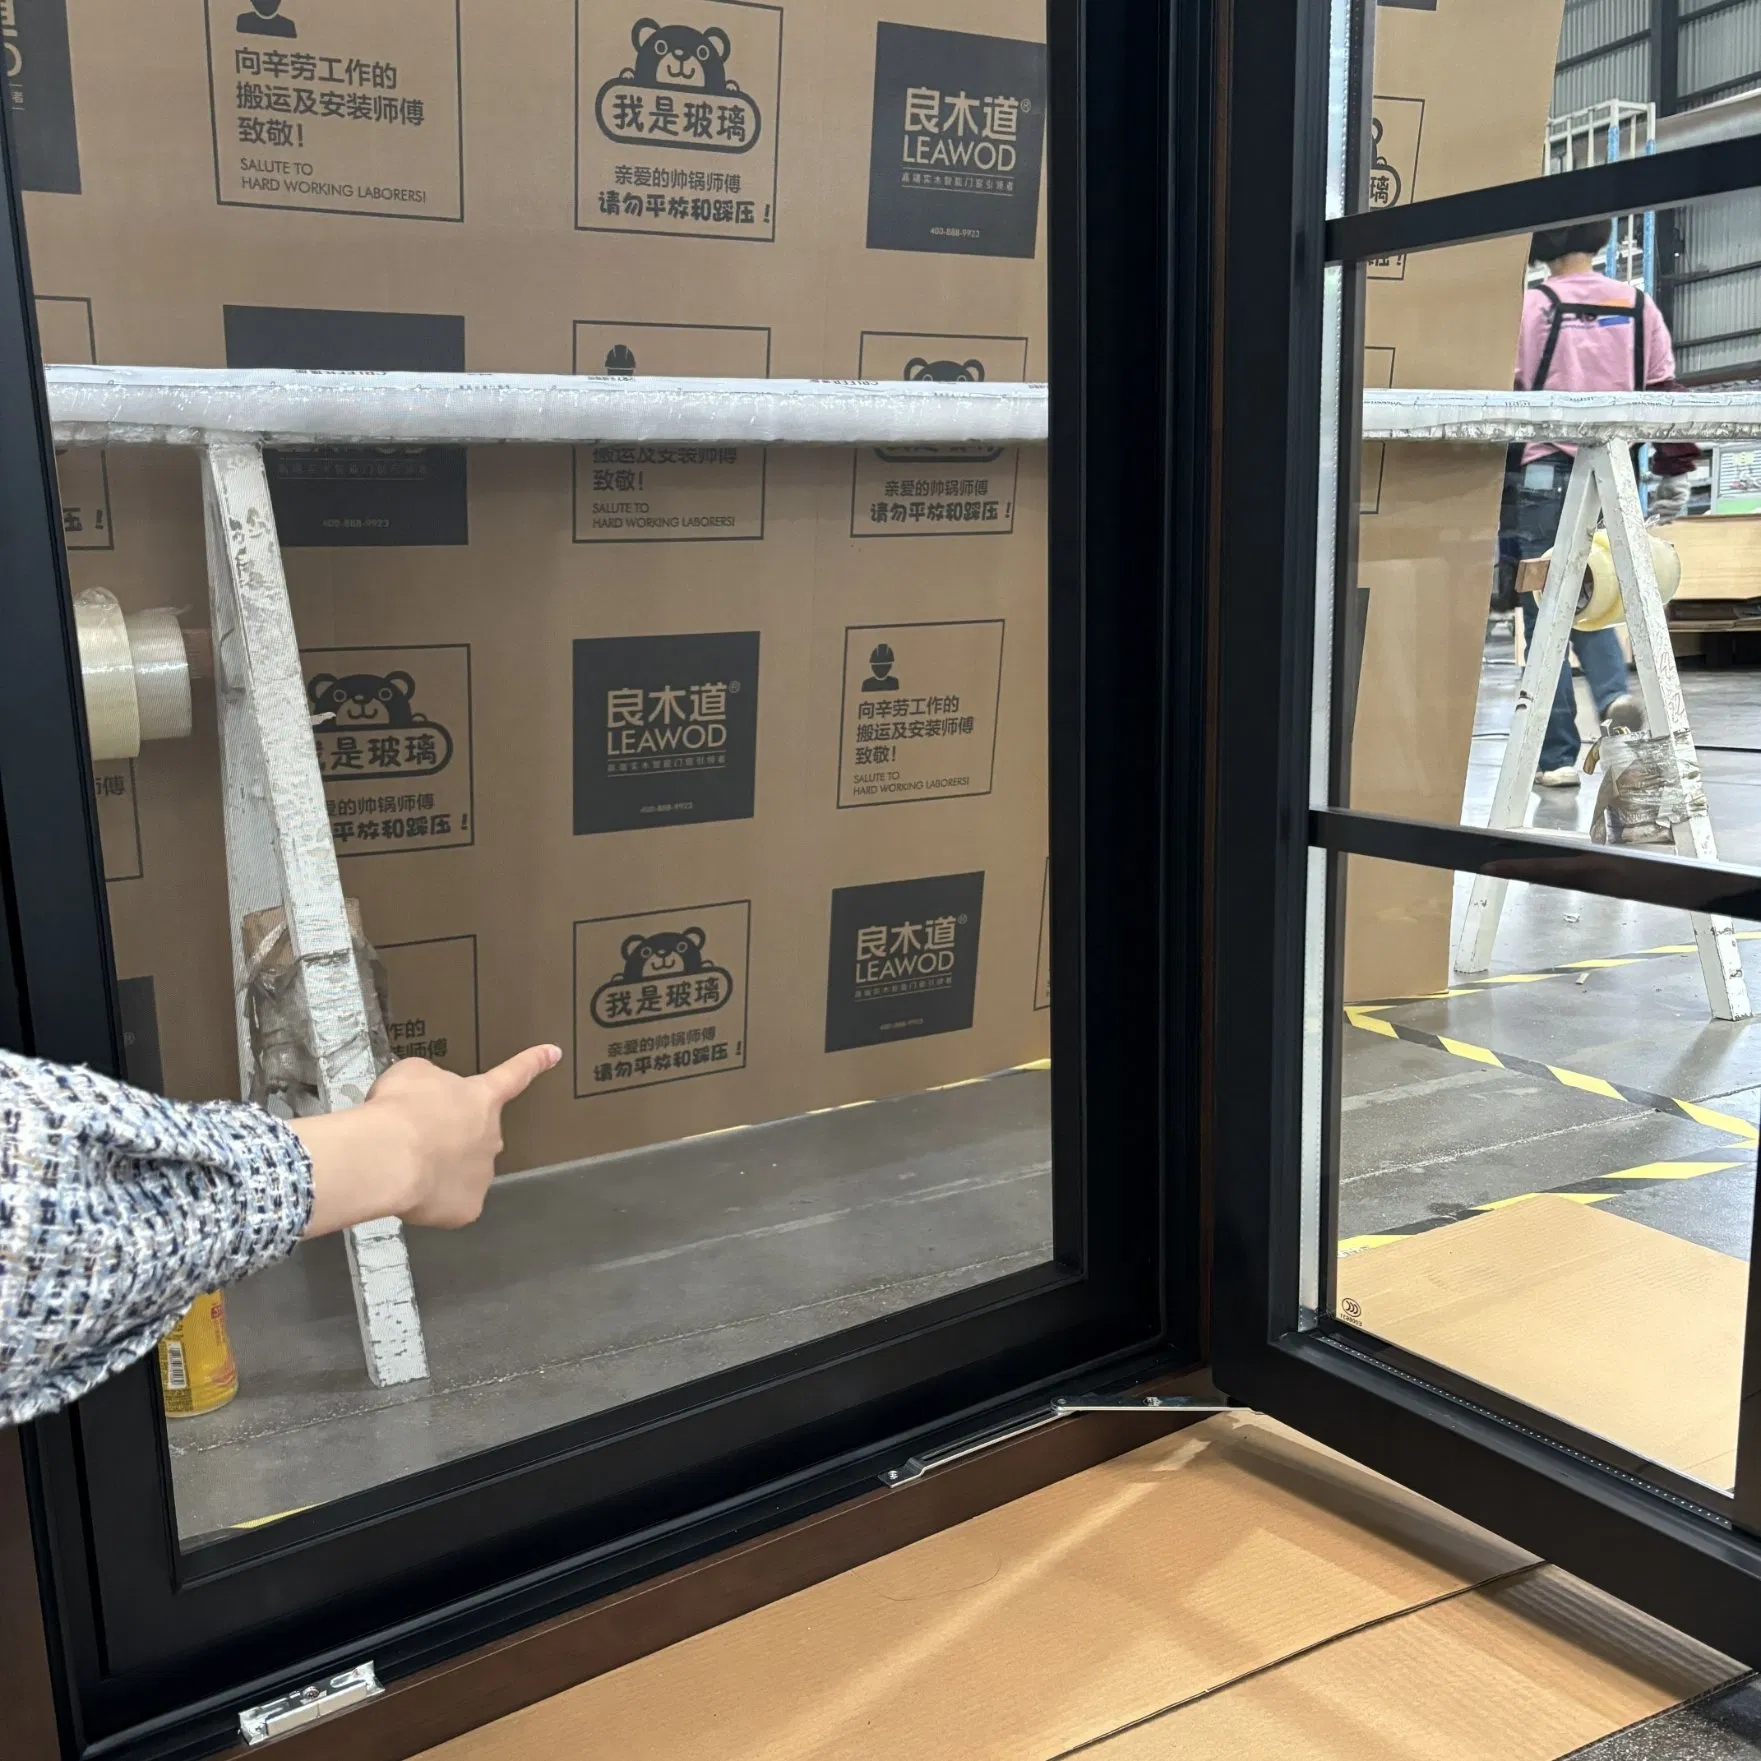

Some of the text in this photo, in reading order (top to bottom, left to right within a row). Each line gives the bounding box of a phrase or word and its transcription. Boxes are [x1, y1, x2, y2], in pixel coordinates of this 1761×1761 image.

[235, 47, 397, 89] 向辛劳工作的
[236, 81, 424, 126] 搬运及安装师傅
[238, 116, 303, 147] 致敬！
[613, 94, 745, 142] 我是玻璃
[240, 158, 313, 176] SALUTE TO
[903, 135, 1016, 171] LEAWOD
[242, 176, 426, 204] HARD WORKING LABORERS!
[615, 165, 741, 193] 亲爱的帅锅师傅
[598, 190, 770, 224] 请勿平放和踩压！
[593, 469, 643, 491] 致敬！
[885, 479, 988, 497] 亲爱的帅锅师傅
[592, 502, 649, 514] SALUTE TO
[592, 516, 735, 528] HARD WORKING LABORERS!
[870, 501, 1011, 523] 请勿平放和踩压！
[858, 695, 960, 720] 向辛劳工作的
[608, 724, 727, 755] LEAWOD
[856, 716, 974, 742] 搬运及安装师傅
[855, 745, 896, 765] 致敬！
[853, 771, 901, 784] SALUTE TO
[853, 776, 970, 796] HARD WORKING LABORERS!
[856, 951, 954, 983] LEAWOD
[605, 977, 719, 1018] 我是玻璃
[608, 1026, 716, 1058] 亲爱的帅锅师傅
